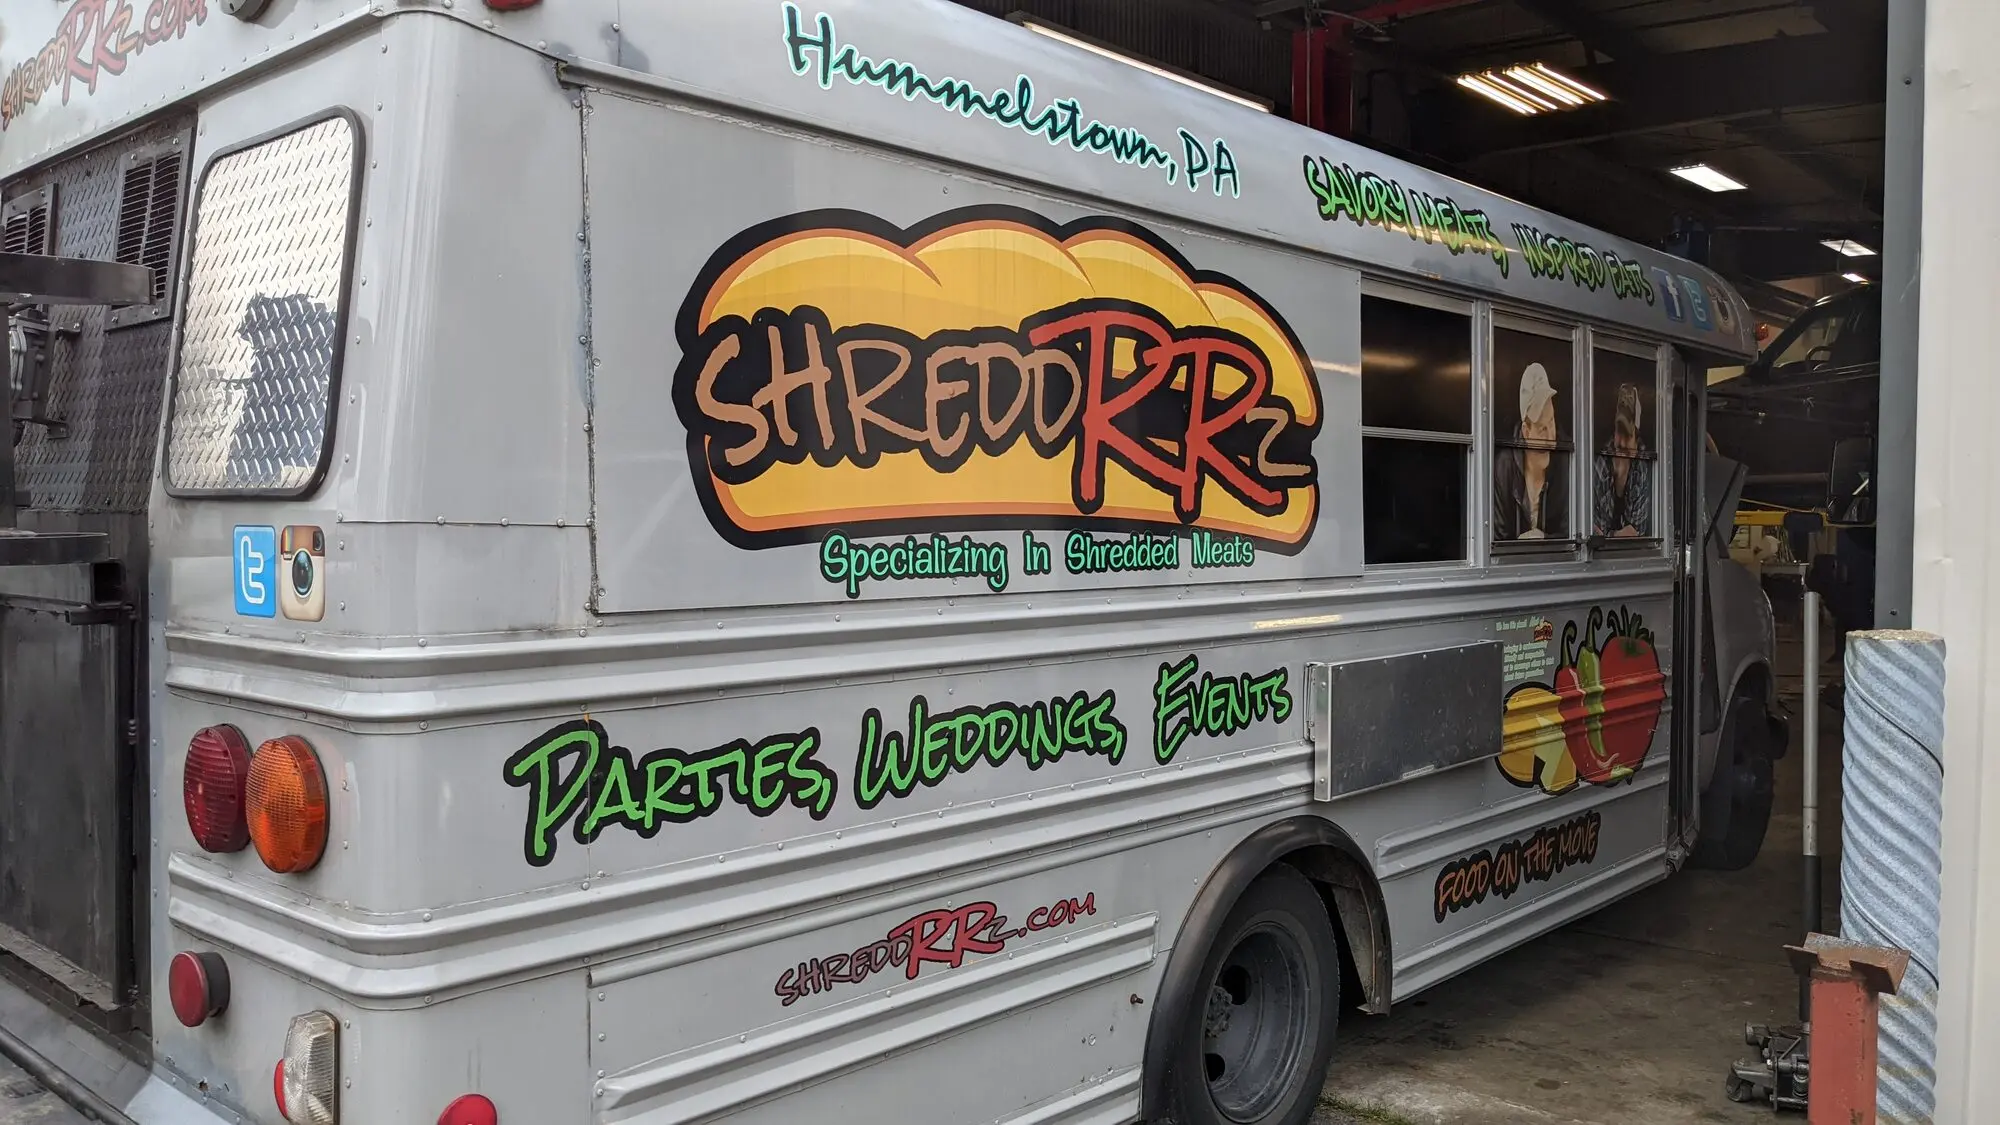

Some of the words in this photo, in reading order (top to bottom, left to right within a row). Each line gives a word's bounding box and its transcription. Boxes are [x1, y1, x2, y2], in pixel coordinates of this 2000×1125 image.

[783, 2, 1177, 183] Hummelstown,
[1178, 128, 1239, 198] PA
[1304, 156, 1416, 240] SAVORY
[1410, 189, 1509, 279] MEATS,
[1511, 223, 1604, 291] INSPIRED
[1604, 252, 1654, 305] EATS
[822, 533, 1007, 595] Specializing
[1024, 531, 1049, 573] In
[1066, 531, 1179, 571] Shredded
[1191, 531, 1255, 566] Meats
[1436, 854, 1491, 917] FOOD
[1493, 844, 1520, 895] ON
[1522, 831, 1555, 879] THE
[1557, 813, 1600, 870] MOVE
